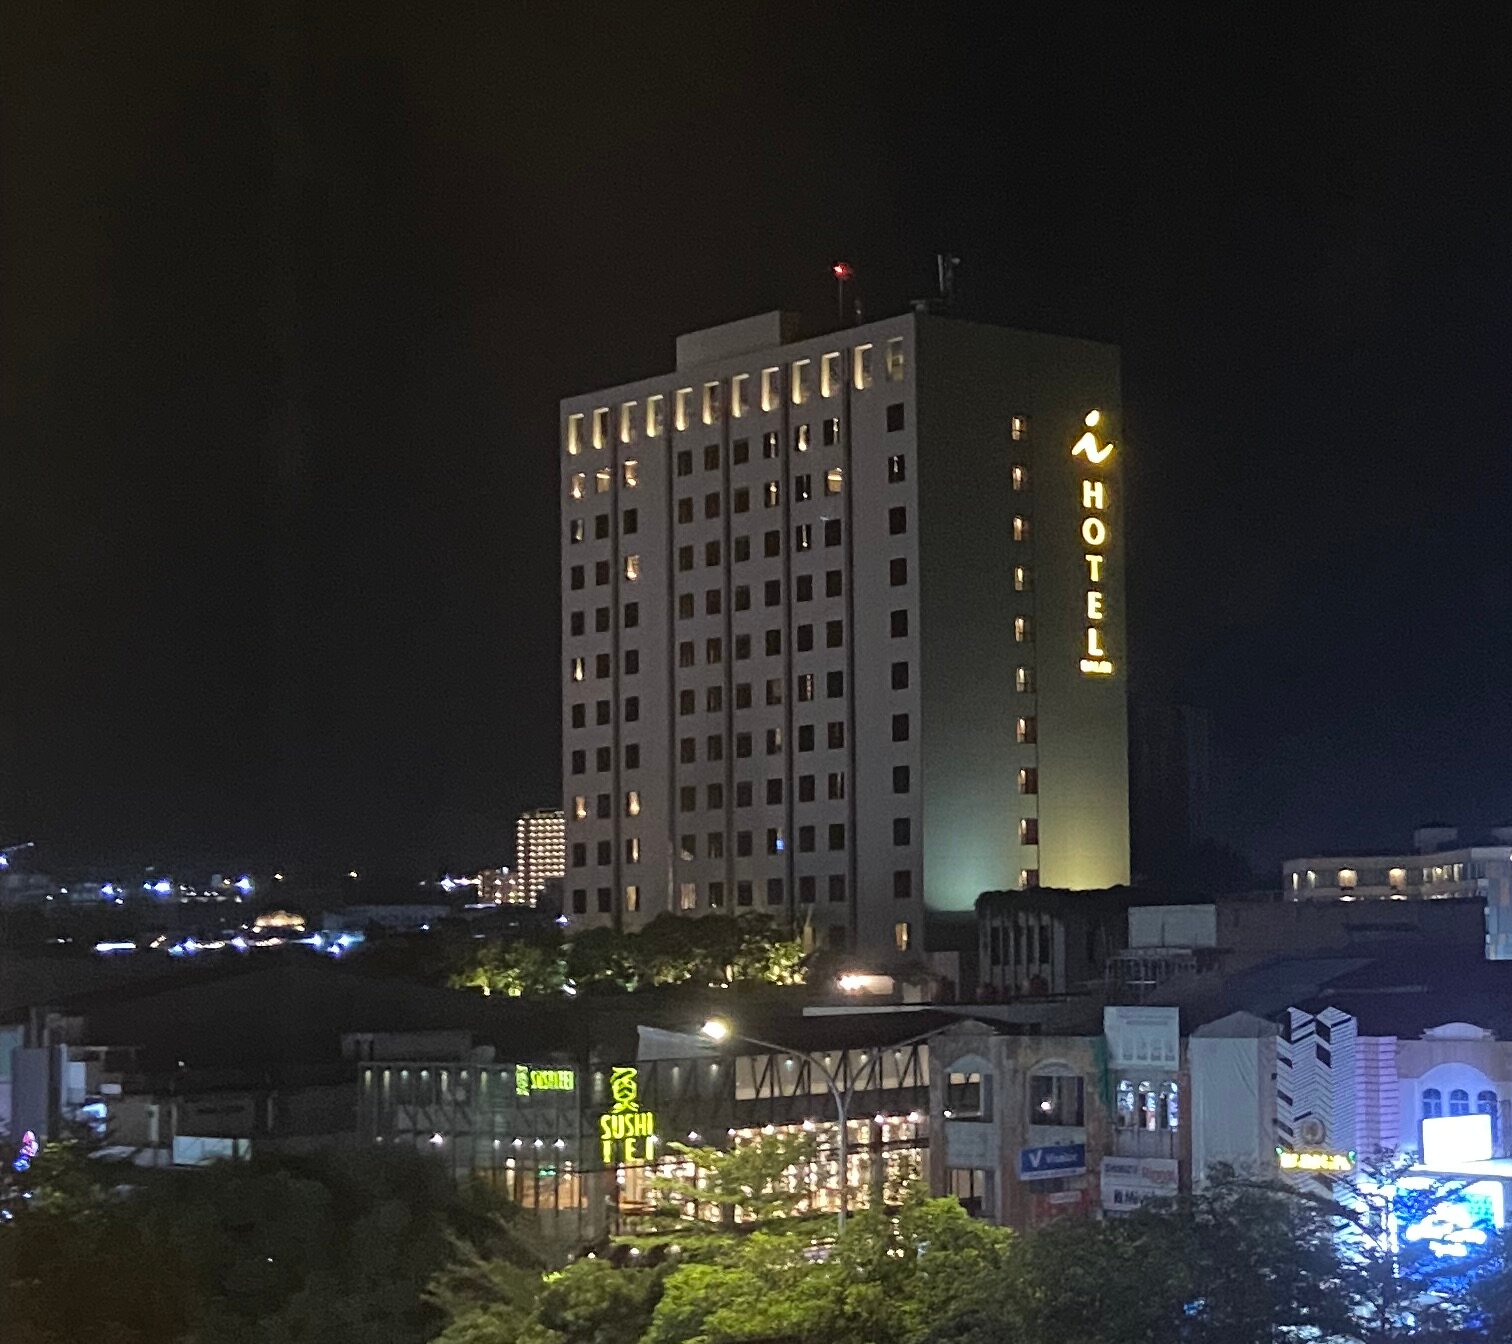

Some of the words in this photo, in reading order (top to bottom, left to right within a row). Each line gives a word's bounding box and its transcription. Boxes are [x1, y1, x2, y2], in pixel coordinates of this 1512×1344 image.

[1082, 480, 1106, 657] HOTEL
[600, 1112, 654, 1140] SUSHI
[601, 1136, 655, 1164] TEI
